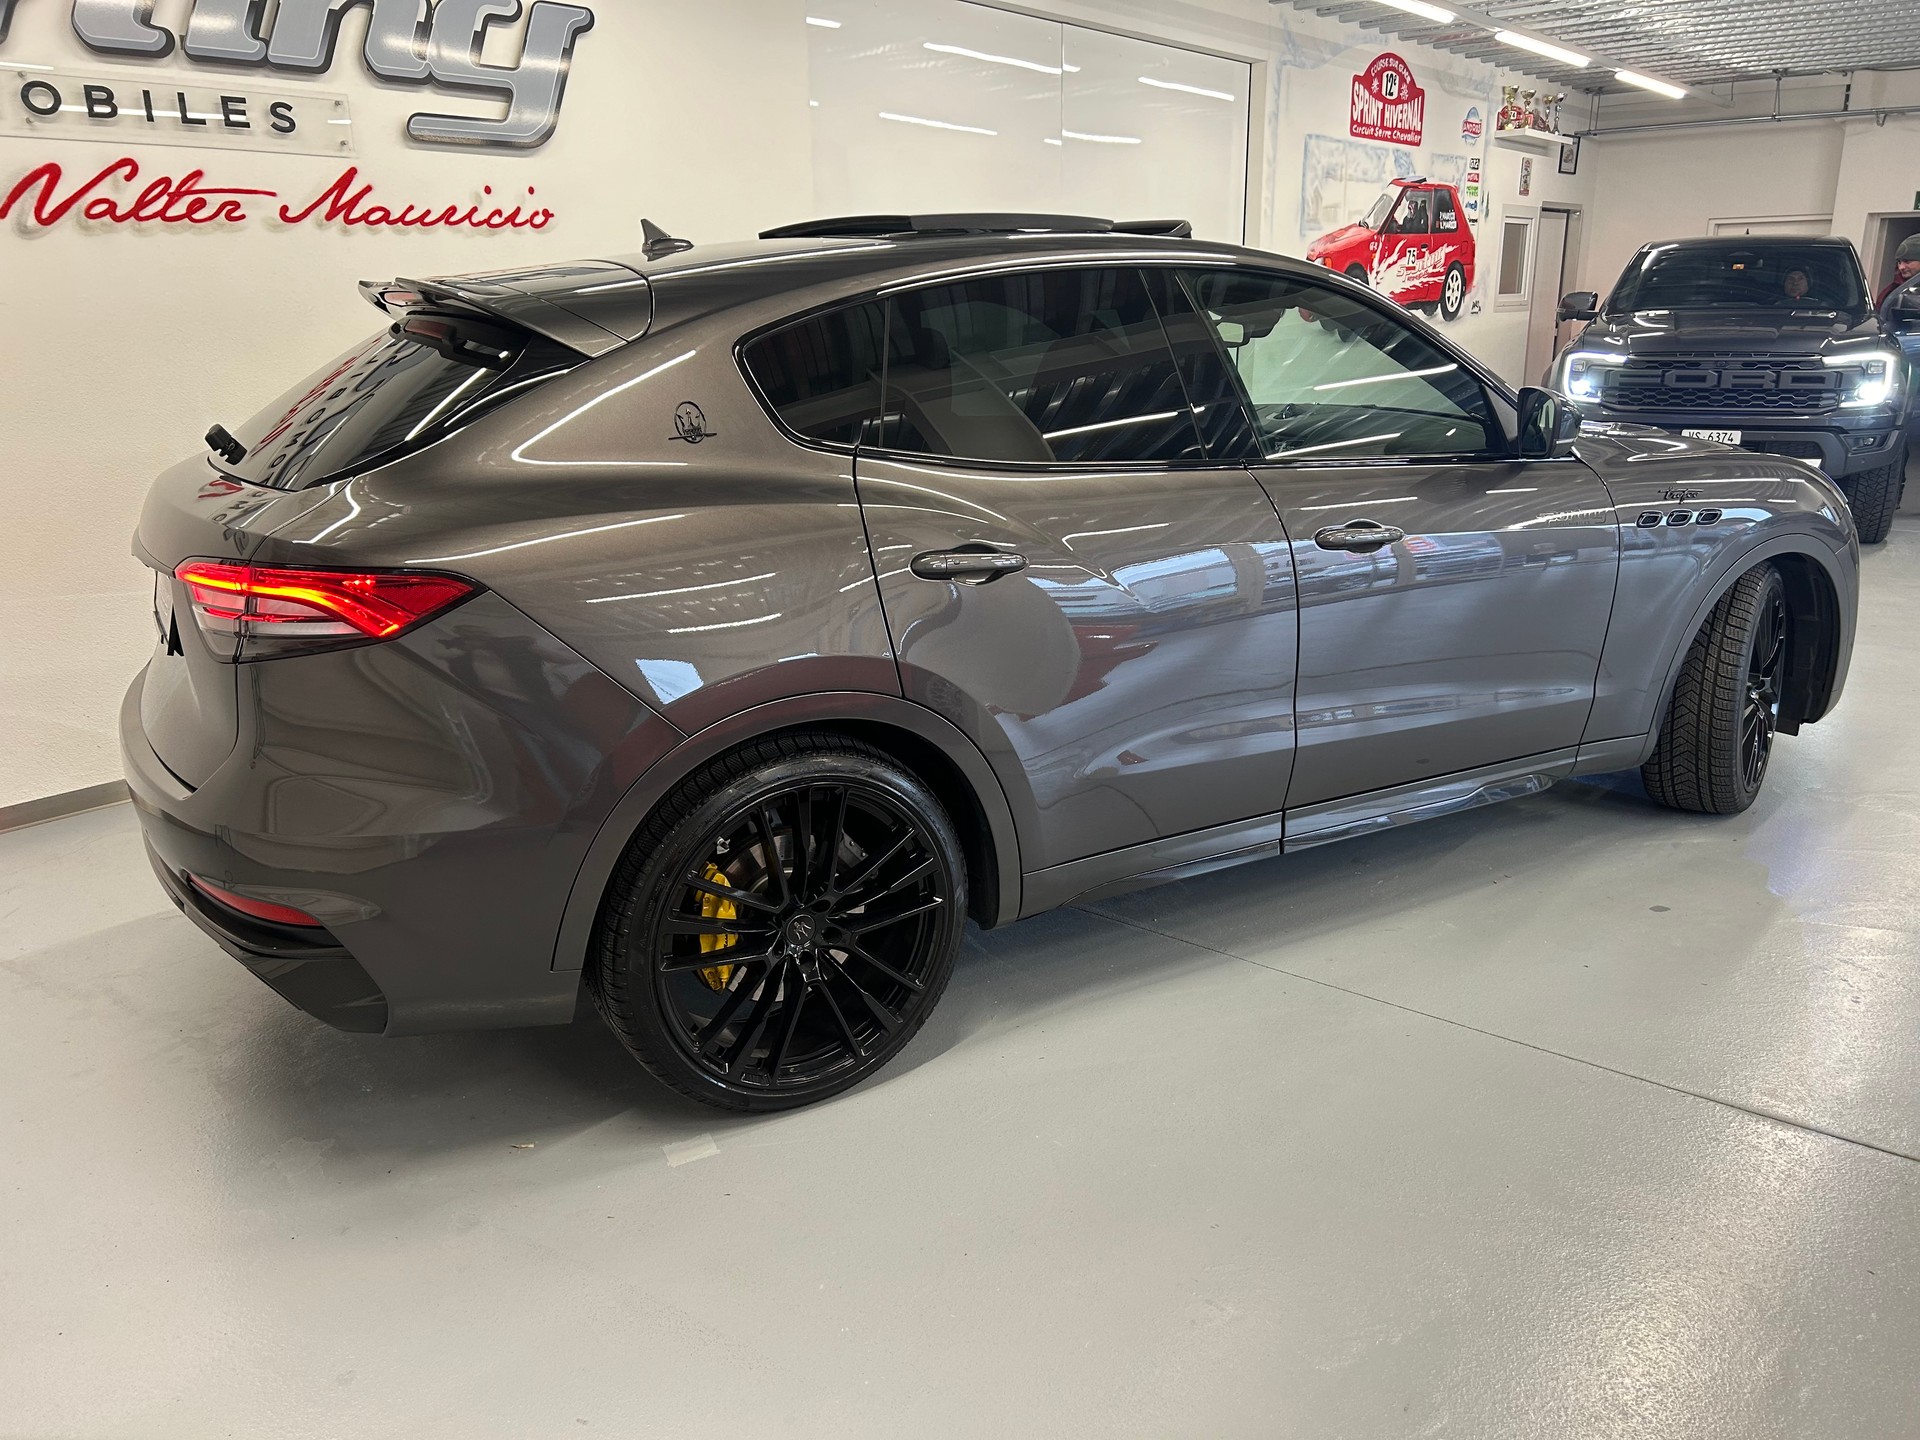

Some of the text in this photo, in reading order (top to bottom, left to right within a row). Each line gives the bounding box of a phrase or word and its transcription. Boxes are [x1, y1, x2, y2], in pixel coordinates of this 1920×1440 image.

[20, 80, 297, 133] OBILES
[1352, 81, 1422, 131] SPRINT HIVERNAL
[1352, 124, 1374, 135] Circuit
[1375, 126, 1392, 138] Serre
[279, 166, 554, 230] Mauricio
[1407, 249, 1416, 265] 75
[1606, 369, 1840, 389] FORD
